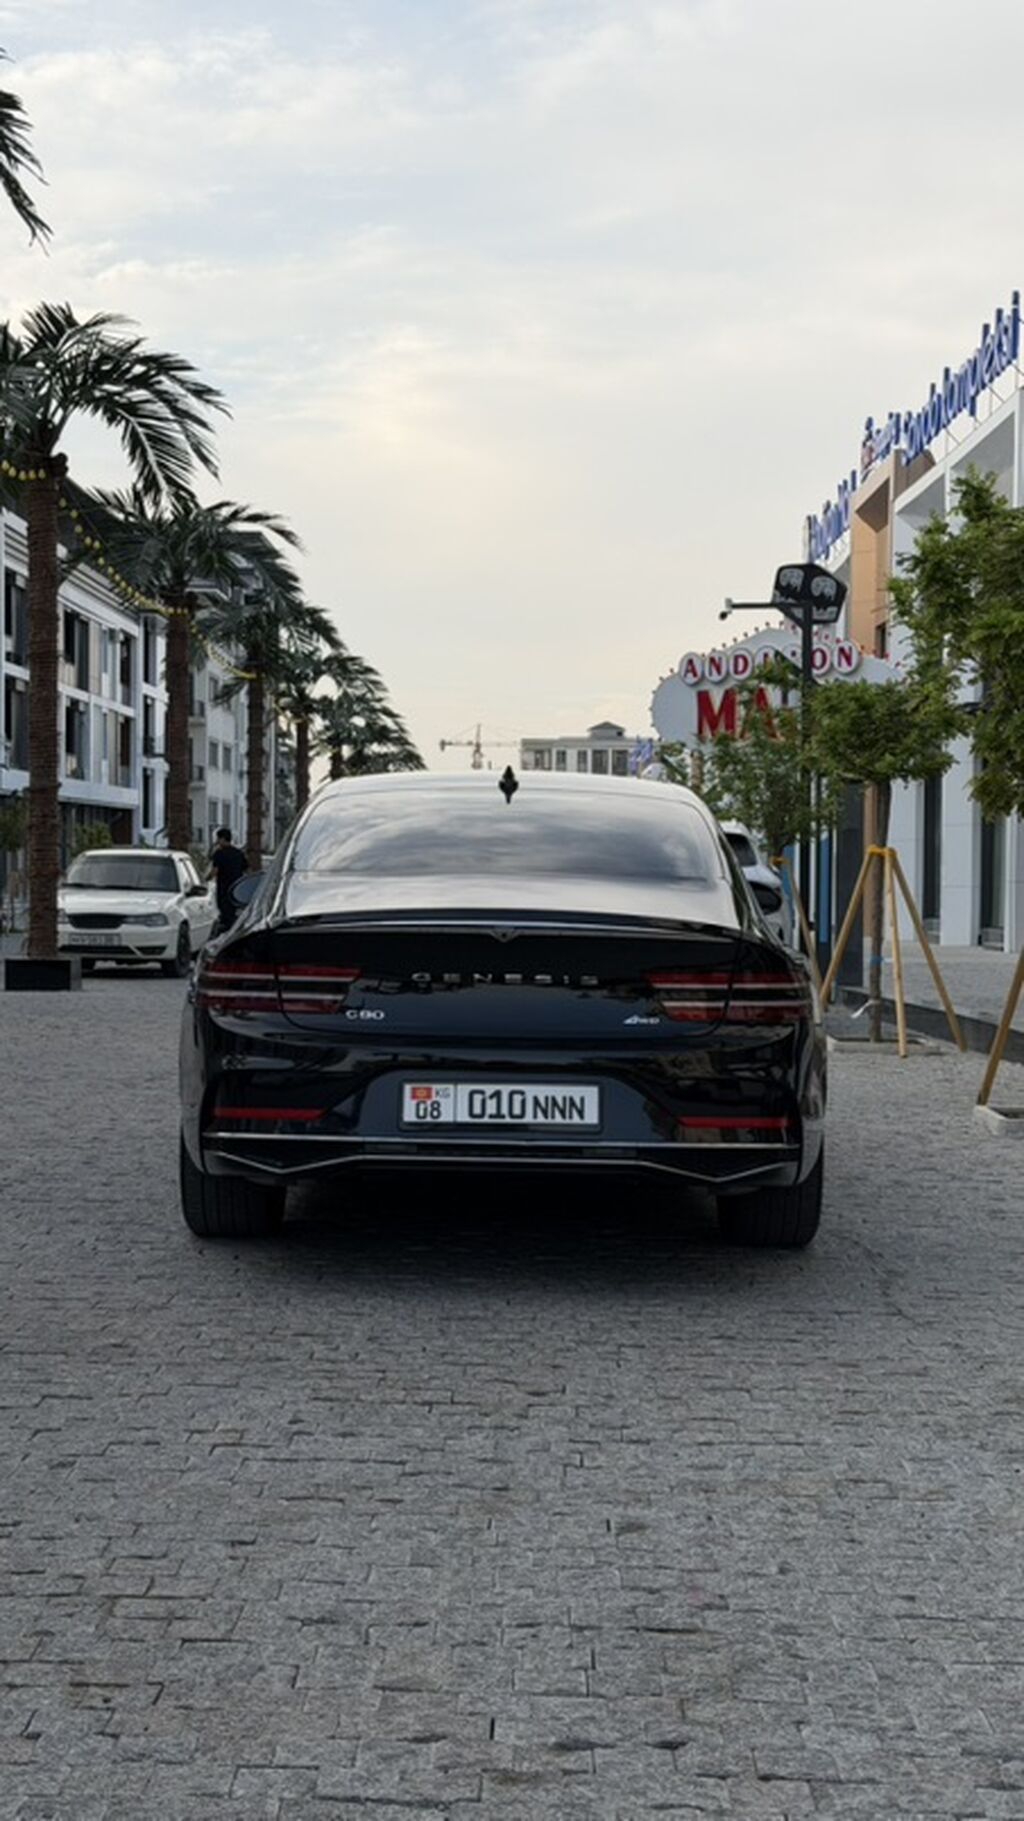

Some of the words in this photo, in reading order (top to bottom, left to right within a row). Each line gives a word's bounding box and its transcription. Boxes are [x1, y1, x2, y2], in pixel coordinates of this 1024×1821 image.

[683, 645, 854, 679] ANDON
[411, 972, 599, 986] GENESIS
[435, 1087, 451, 1098] KG
[415, 1100, 442, 1120] 08
[468, 1089, 527, 1119] 010
[533, 1095, 585, 1121] NNN
